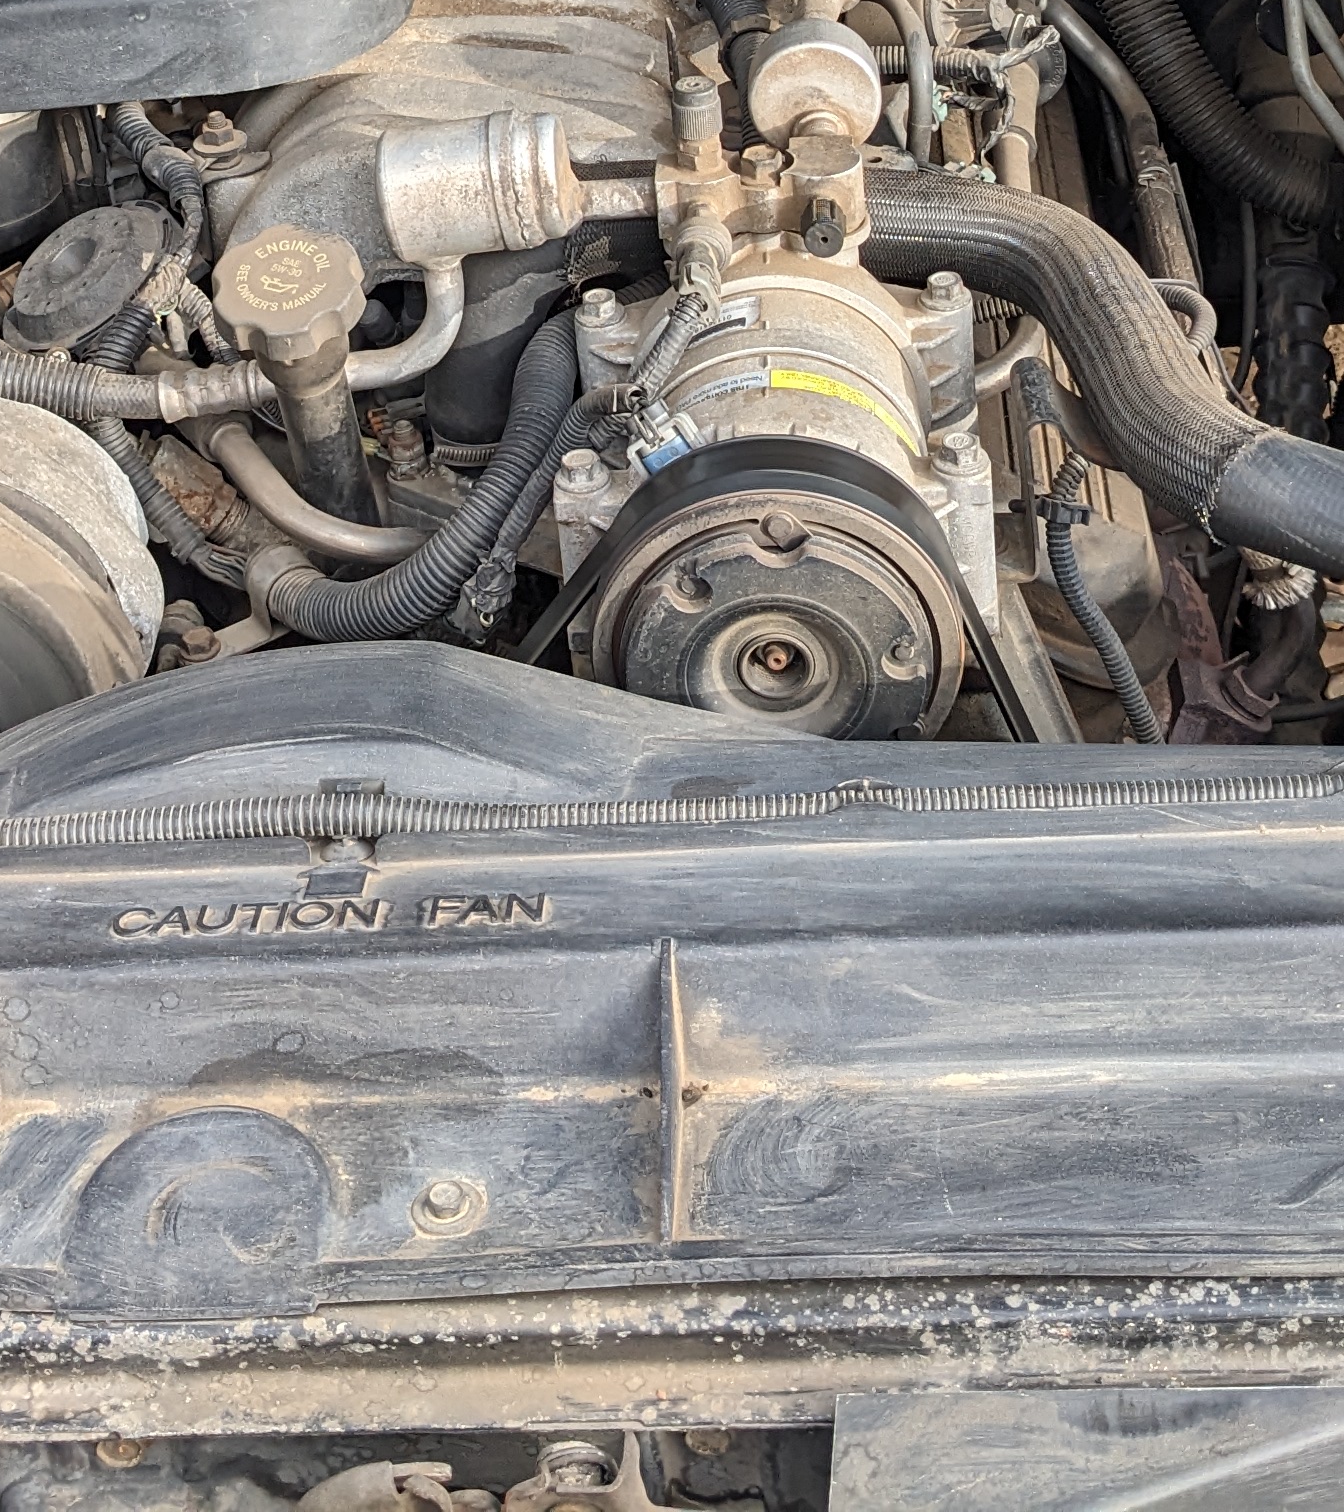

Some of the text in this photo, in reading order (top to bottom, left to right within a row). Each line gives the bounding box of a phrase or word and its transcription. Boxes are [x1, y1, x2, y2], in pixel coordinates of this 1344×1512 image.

[255, 240, 331, 272] ENGINE OIL
[281, 257, 302, 268] SAE
[236, 264, 327, 311] SEE OWNER'S MANUAL
[112, 891, 552, 940] CAUTION FAN
